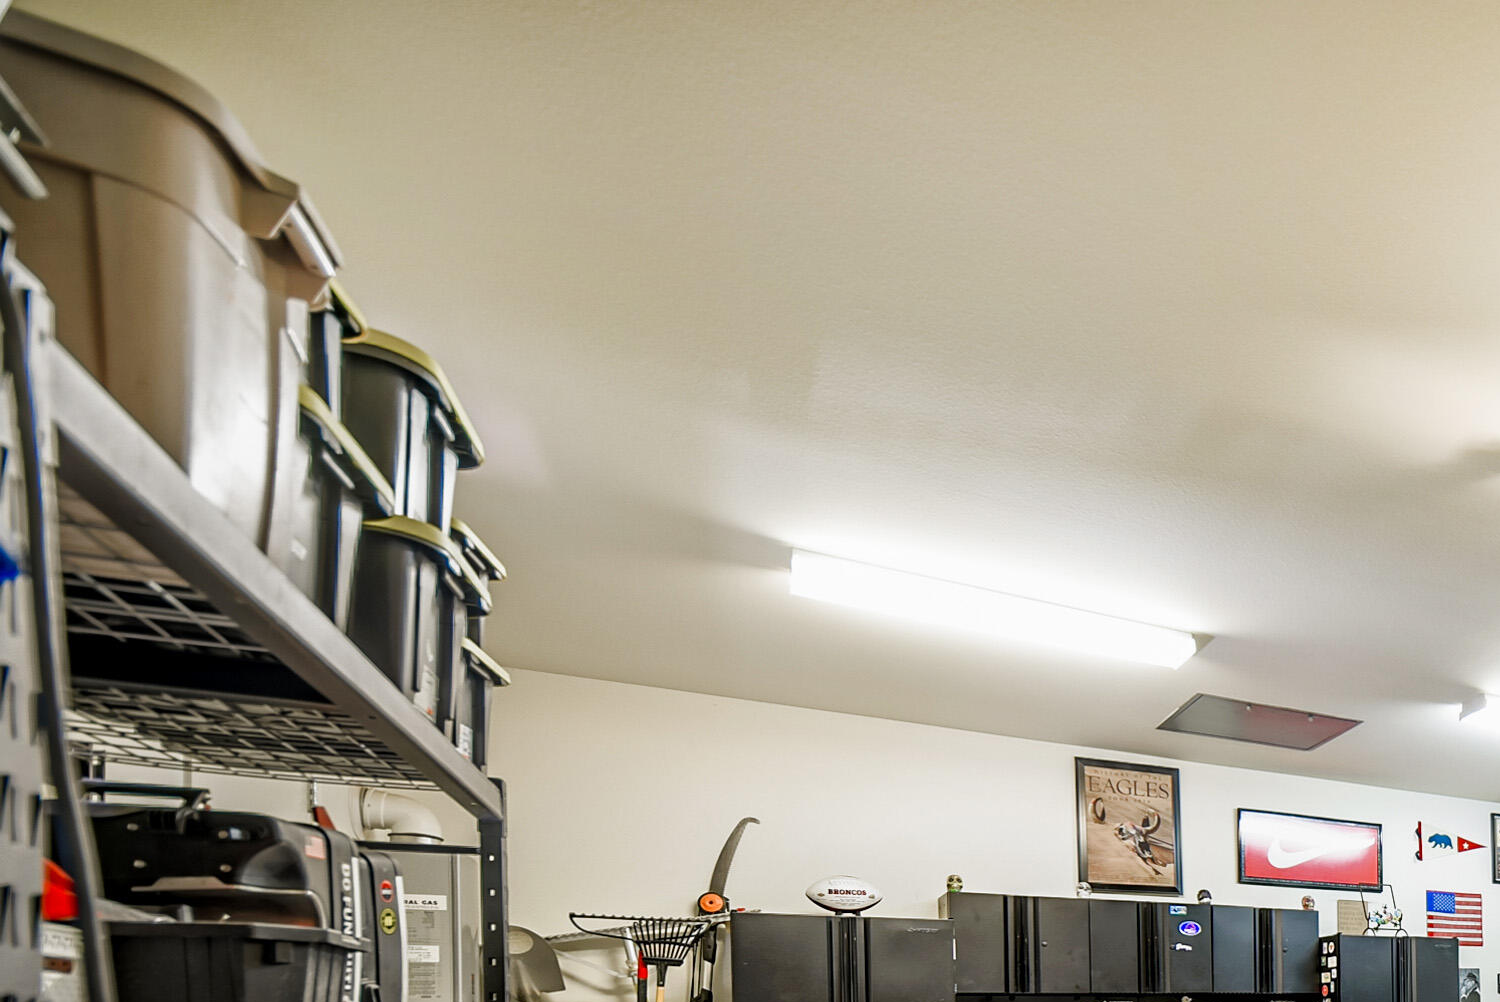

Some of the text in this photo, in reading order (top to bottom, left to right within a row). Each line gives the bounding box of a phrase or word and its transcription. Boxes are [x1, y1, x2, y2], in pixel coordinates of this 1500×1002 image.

[1088, 775, 1170, 800] EAGLES
[341, 863, 352, 892] DO
[827, 888, 867, 896] BRONCOS
[342, 895, 354, 935] FUN
